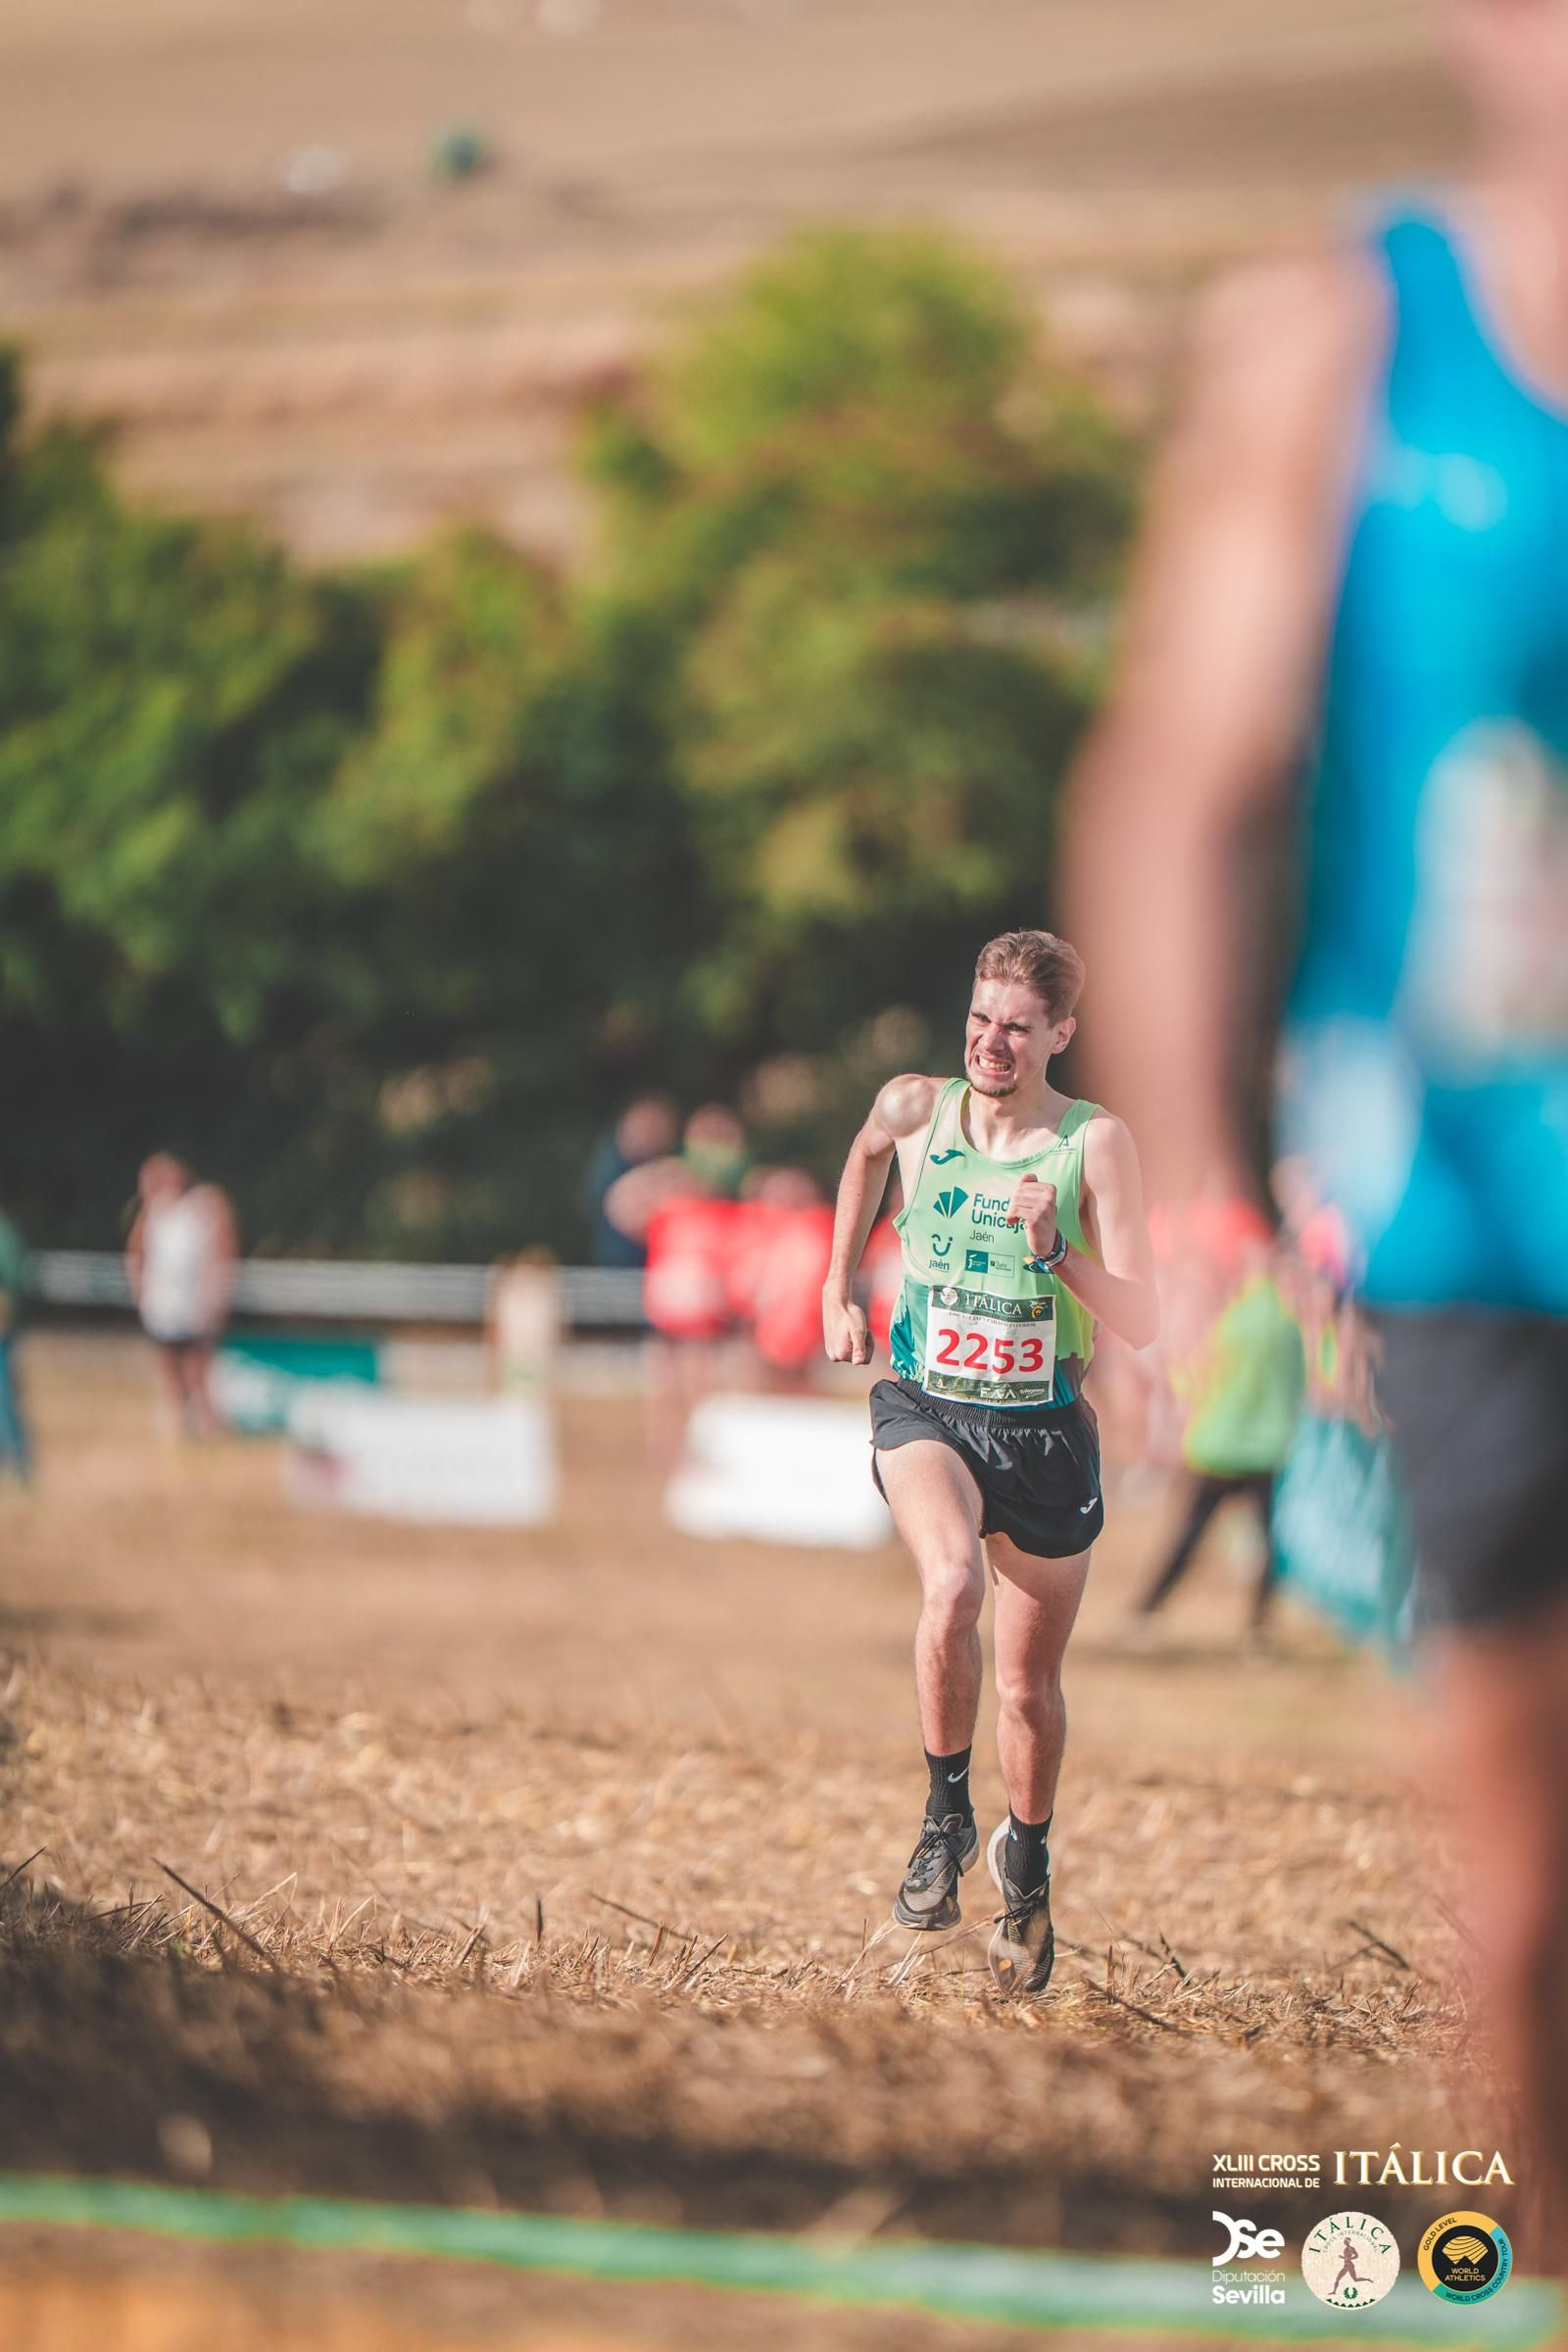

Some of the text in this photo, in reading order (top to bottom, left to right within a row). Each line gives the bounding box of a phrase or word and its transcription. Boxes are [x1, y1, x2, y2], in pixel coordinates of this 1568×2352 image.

[974, 1193, 1010, 1212] Fund
[970, 1230, 995, 1244] Jaén
[964, 1294, 1023, 1315] ITÁLICA
[936, 1328, 1044, 1374] 2253
